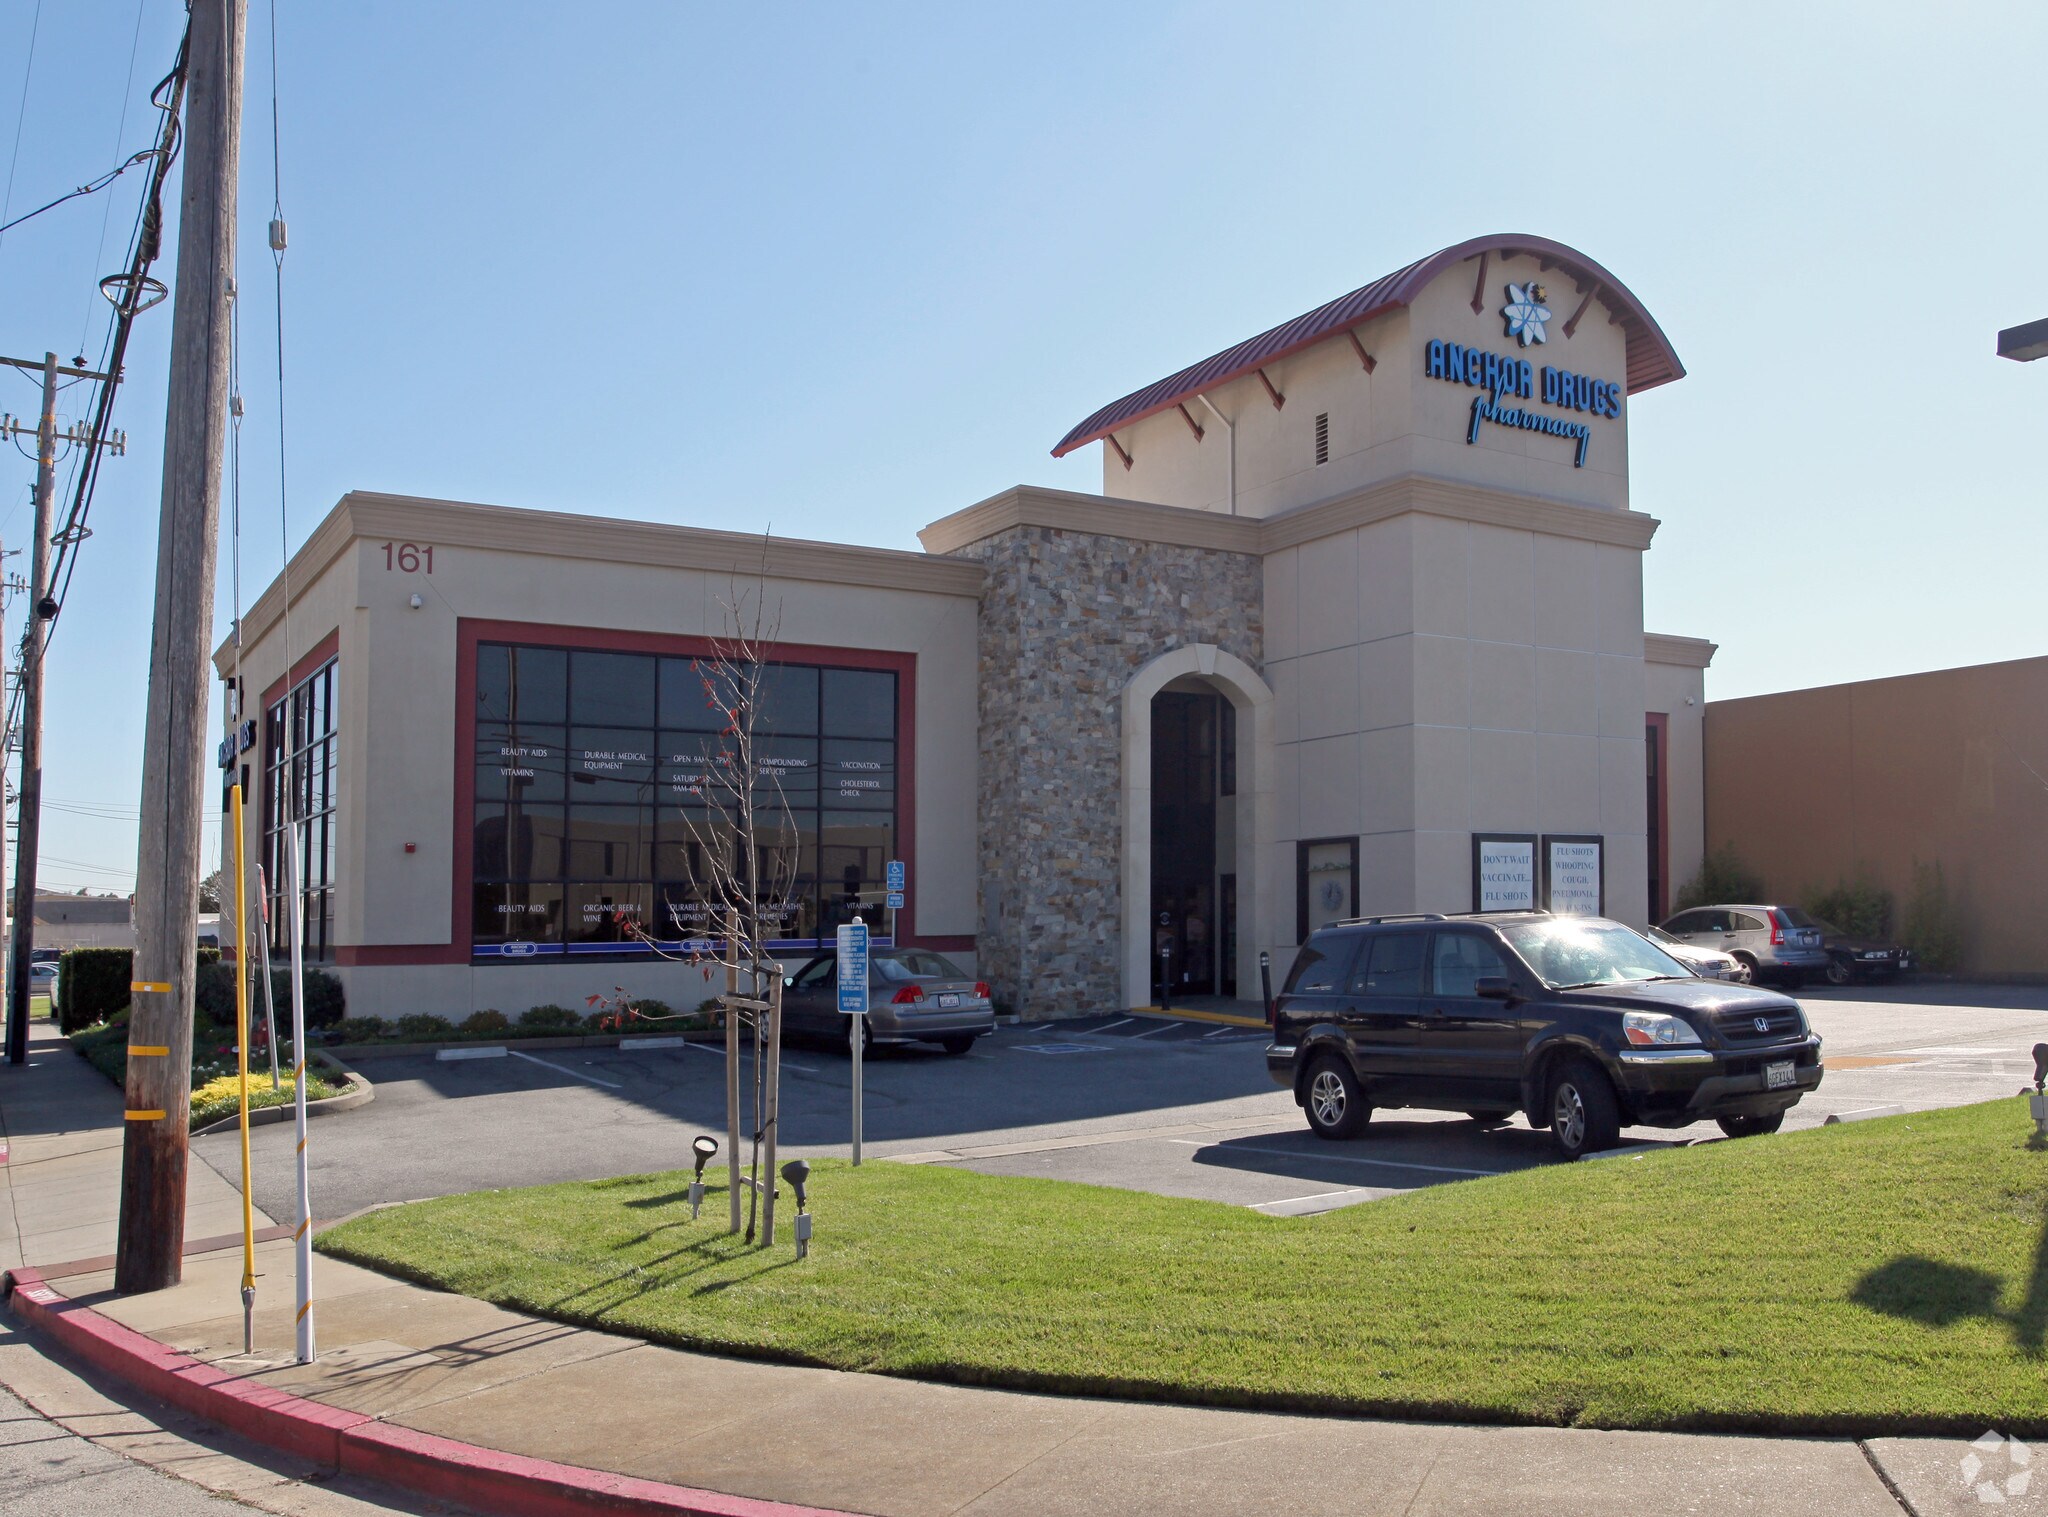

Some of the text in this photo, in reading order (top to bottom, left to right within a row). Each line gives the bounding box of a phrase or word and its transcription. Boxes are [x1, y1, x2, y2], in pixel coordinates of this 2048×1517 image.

[1425, 338, 1621, 419] ANCHOR DRUGS
[1466, 374, 1591, 468] pharmacy
[381, 542, 433, 574] 161
[500, 748, 548, 757] BEAUTY AIDS
[584, 751, 647, 761] DURABLE MEDICAL
[673, 754, 691, 763] OPEN
[759, 757, 808, 767] COMPOUNDING
[584, 761, 623, 770] EQUIPMENT
[841, 761, 881, 770] VACCINATION
[500, 768, 534, 777] VITAMINS
[673, 774, 710, 783] SATURDS
[841, 779, 880, 788] CHOLESTEROL
[841, 789, 860, 797] CHECK
[1556, 847, 1571, 855] FLU
[1483, 855, 1530, 864] DON'T WAIT
[1555, 862, 1594, 870] WHOOPING
[1485, 892, 1529, 900] FLU SHOTS
[498, 904, 545, 913] BEAUTY AIDS
[583, 904, 615, 912] ORGANIC
[618, 904, 634, 912] BEER
[670, 903, 699, 911] DURABLE
[846, 902, 874, 910] VITAMINS
[583, 914, 601, 922] WINE
